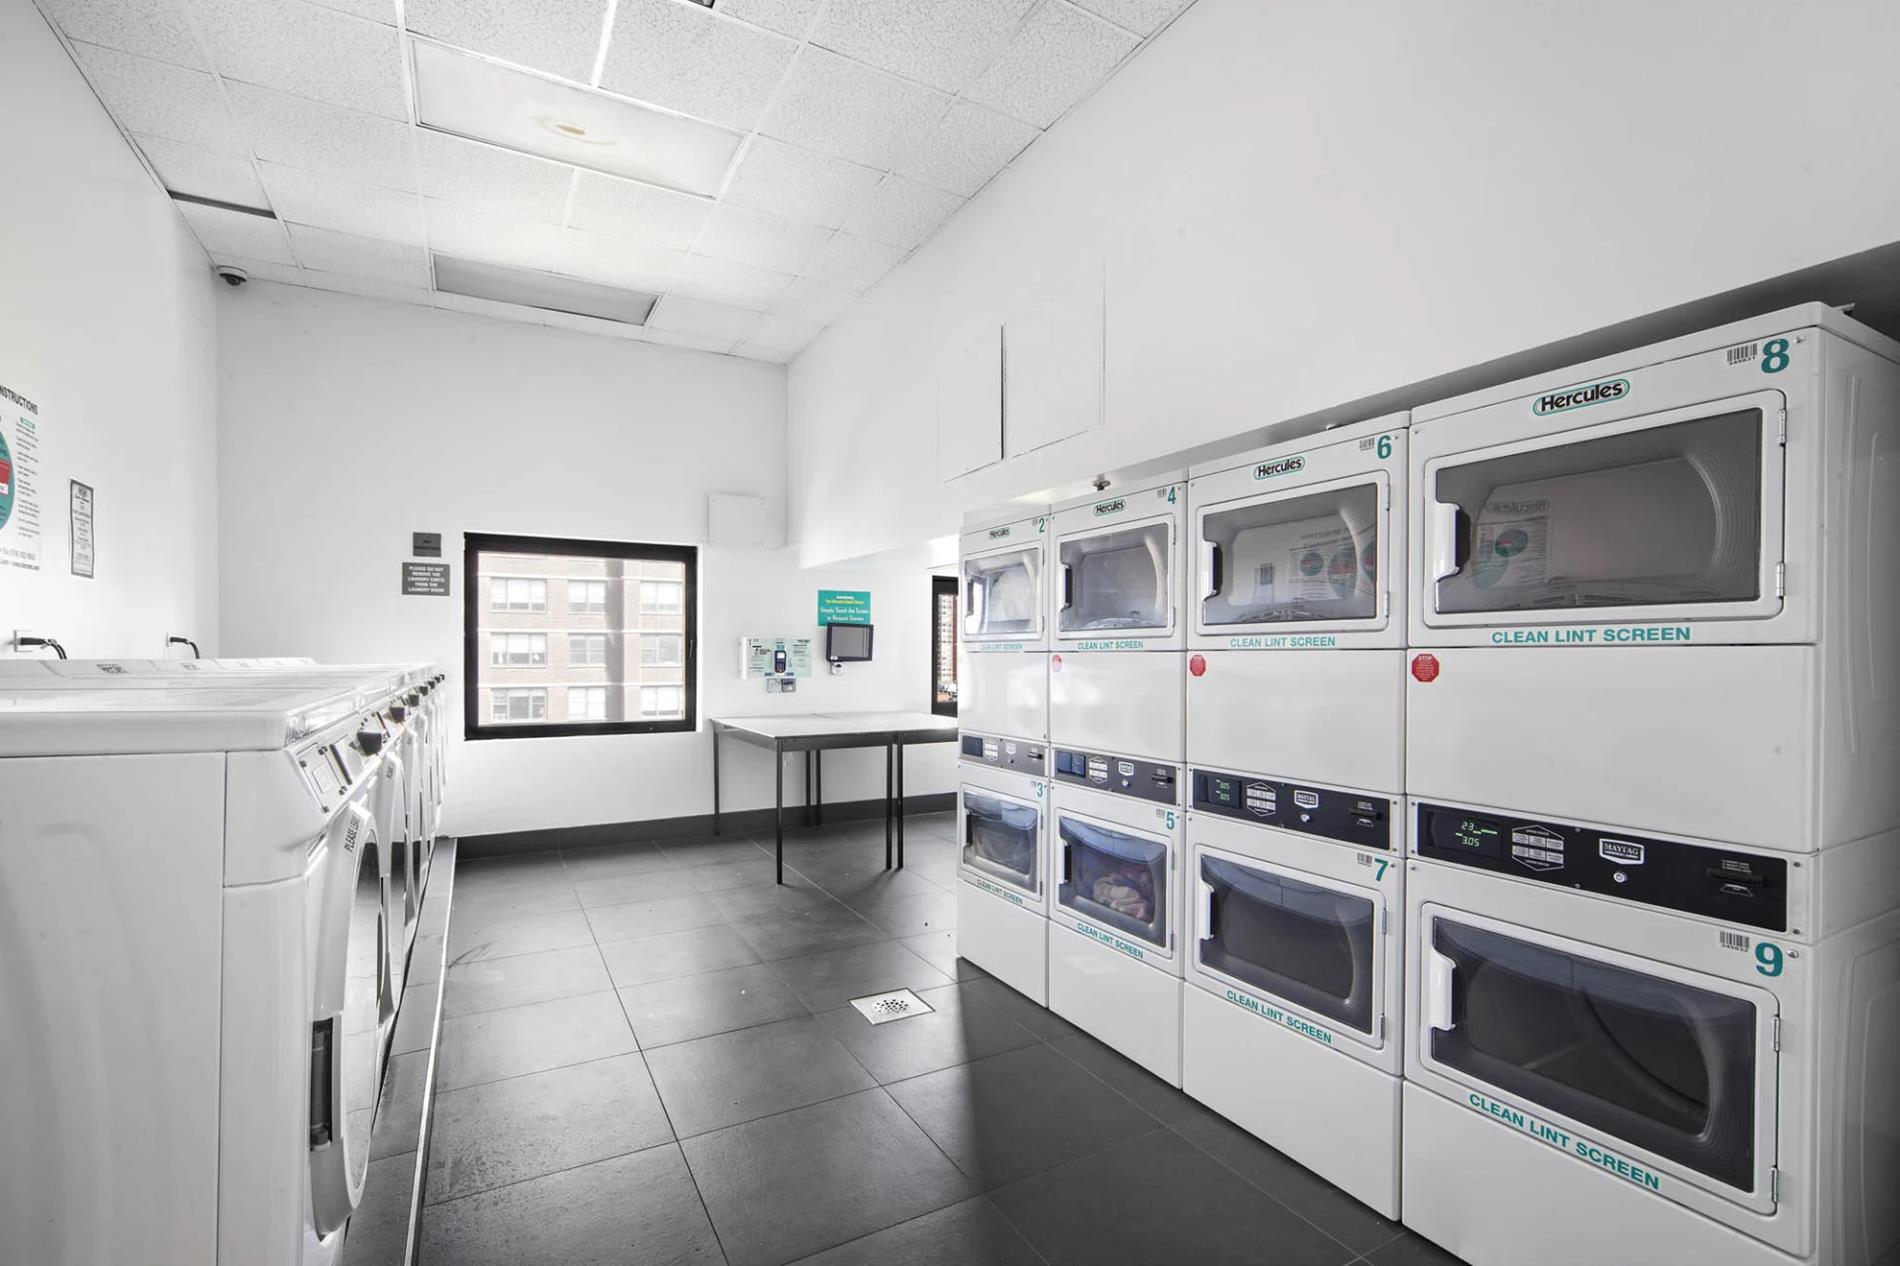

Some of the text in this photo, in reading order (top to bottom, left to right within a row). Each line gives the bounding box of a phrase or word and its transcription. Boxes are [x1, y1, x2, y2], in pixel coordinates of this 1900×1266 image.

[1761, 338, 1790, 374] 8
[1540, 381, 1624, 413] Hercules
[1376, 434, 1392, 459] 6
[1257, 457, 1303, 477] Hercules
[1167, 486, 1177, 505] 4
[1095, 500, 1124, 515] Hercules
[989, 527, 1010, 538] Hercules
[1039, 517, 1045, 533] 2
[1230, 636, 1336, 648] CLEAN LINT SCREEN
[1492, 626, 1691, 645] CLEAN LINT SCREEN
[1078, 641, 1143, 650] CLEAN LINT SCREEN
[1036, 782, 1044, 798] 3
[1165, 811, 1176, 830] 5
[1460, 820, 1475, 832] 23
[343, 828, 358, 852] PLEASE
[1603, 842, 1640, 855] MAYTAG
[1374, 857, 1389, 882] 7
[976, 879, 1023, 904] CLEAN LINT SCREEN
[1077, 922, 1144, 959] CLEAN LINT SCREEN
[1755, 942, 1784, 978] 9
[1226, 990, 1332, 1044] CLEAN LINT SCREEN
[1469, 1093, 1660, 1191] CLEAN LINT SCREEN
